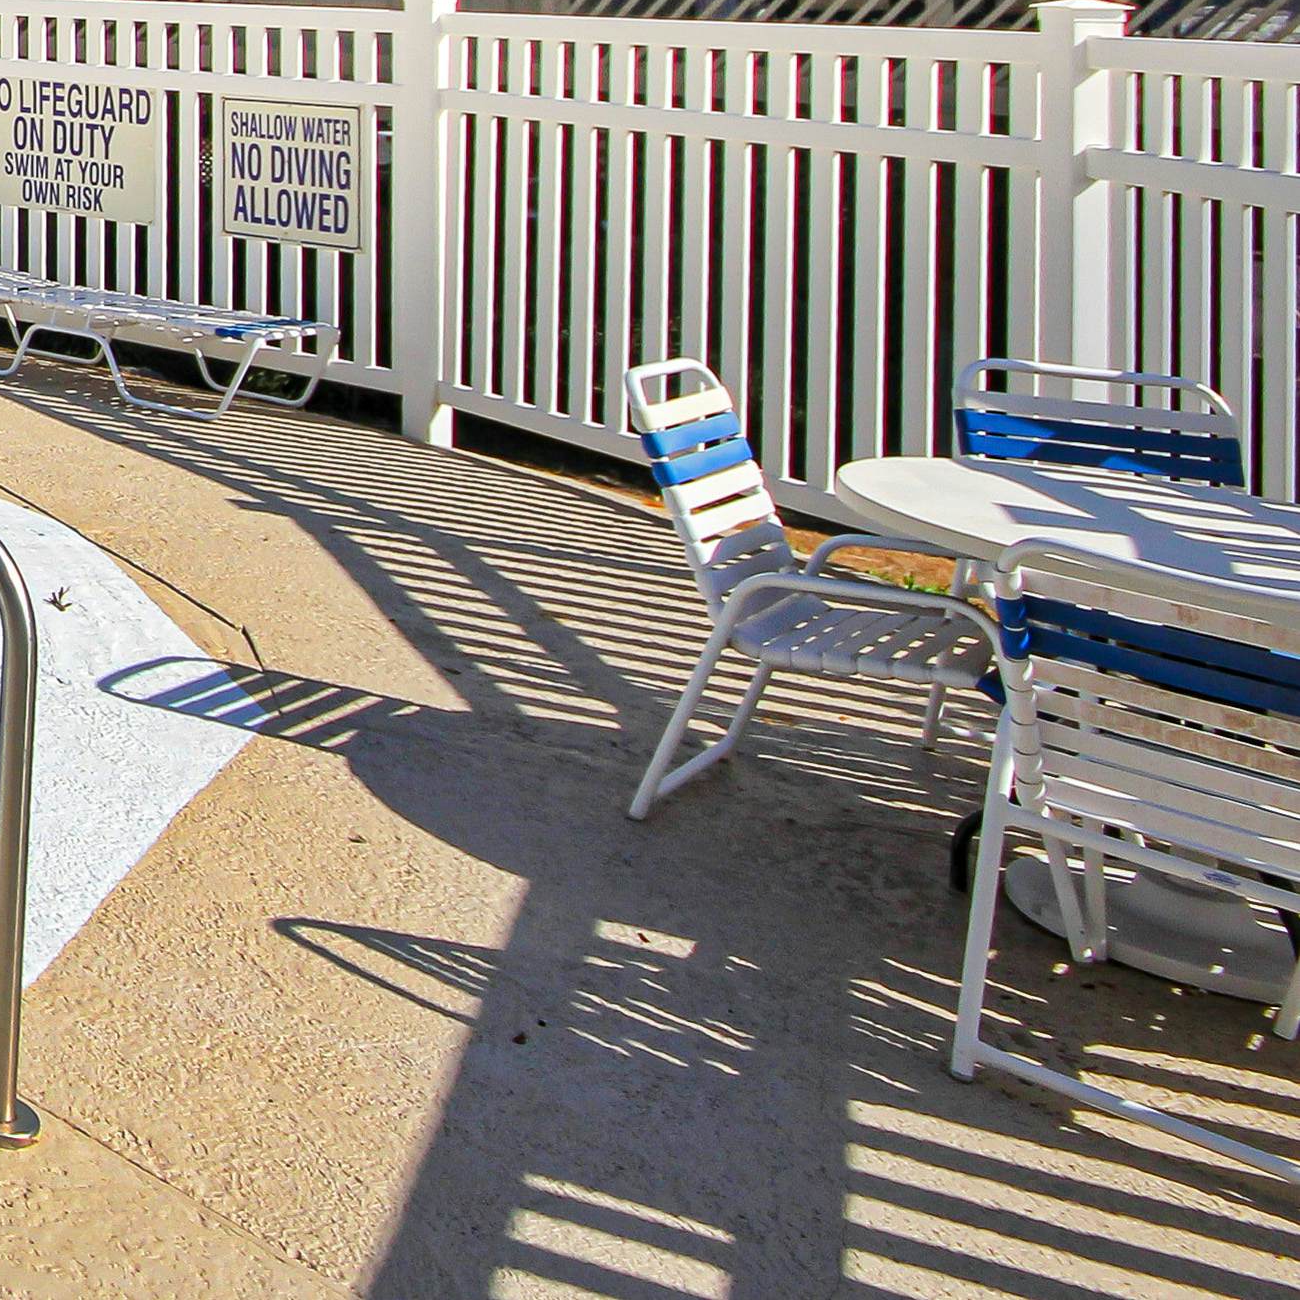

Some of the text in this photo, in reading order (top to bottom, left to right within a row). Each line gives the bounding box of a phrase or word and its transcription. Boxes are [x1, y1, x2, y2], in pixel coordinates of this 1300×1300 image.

[19, 79, 152, 125] LIFEGUARD
[13, 116, 115, 160] ON DUTY
[231, 111, 351, 146] SHALLOW WATER
[4, 152, 124, 189] SWIM AT YOUR
[231, 142, 351, 190] NO DIVING
[22, 179, 104, 212] OWN RISK
[233, 185, 349, 234] ALLOWED
